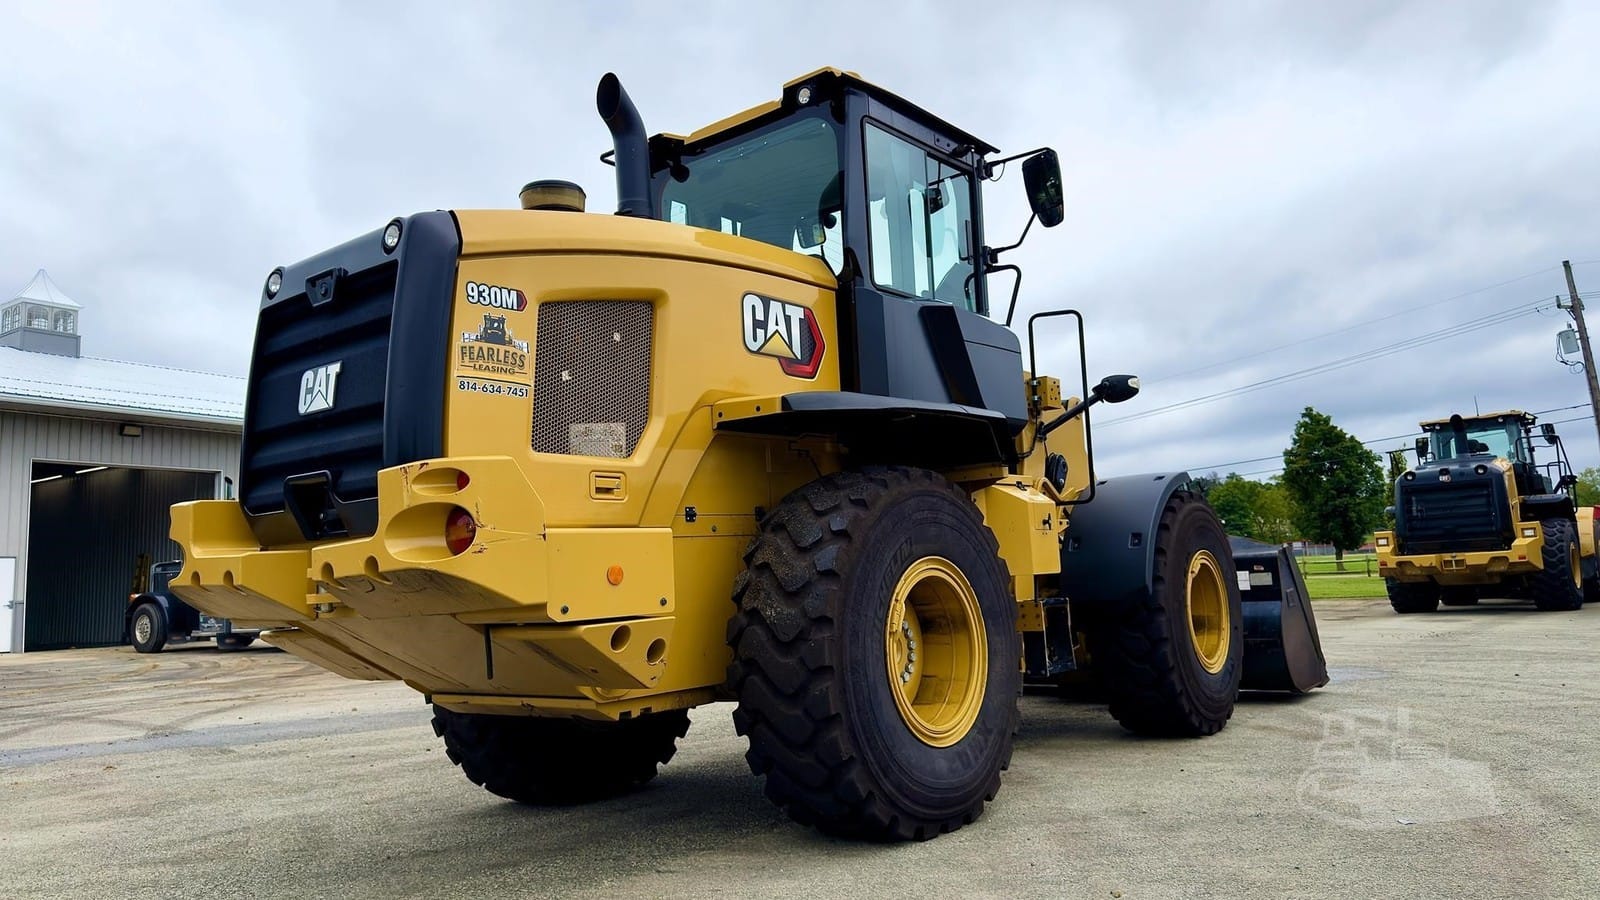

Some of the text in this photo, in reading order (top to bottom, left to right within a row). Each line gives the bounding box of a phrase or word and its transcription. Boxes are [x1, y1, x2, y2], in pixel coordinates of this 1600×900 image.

[466, 281, 518, 310] 930M
[743, 293, 805, 360] CAT
[461, 345, 526, 368] FEARLESS
[473, 363, 516, 375] LEASING
[298, 360, 342, 415] CAT
[459, 380, 528, 398] 814-634-7451
